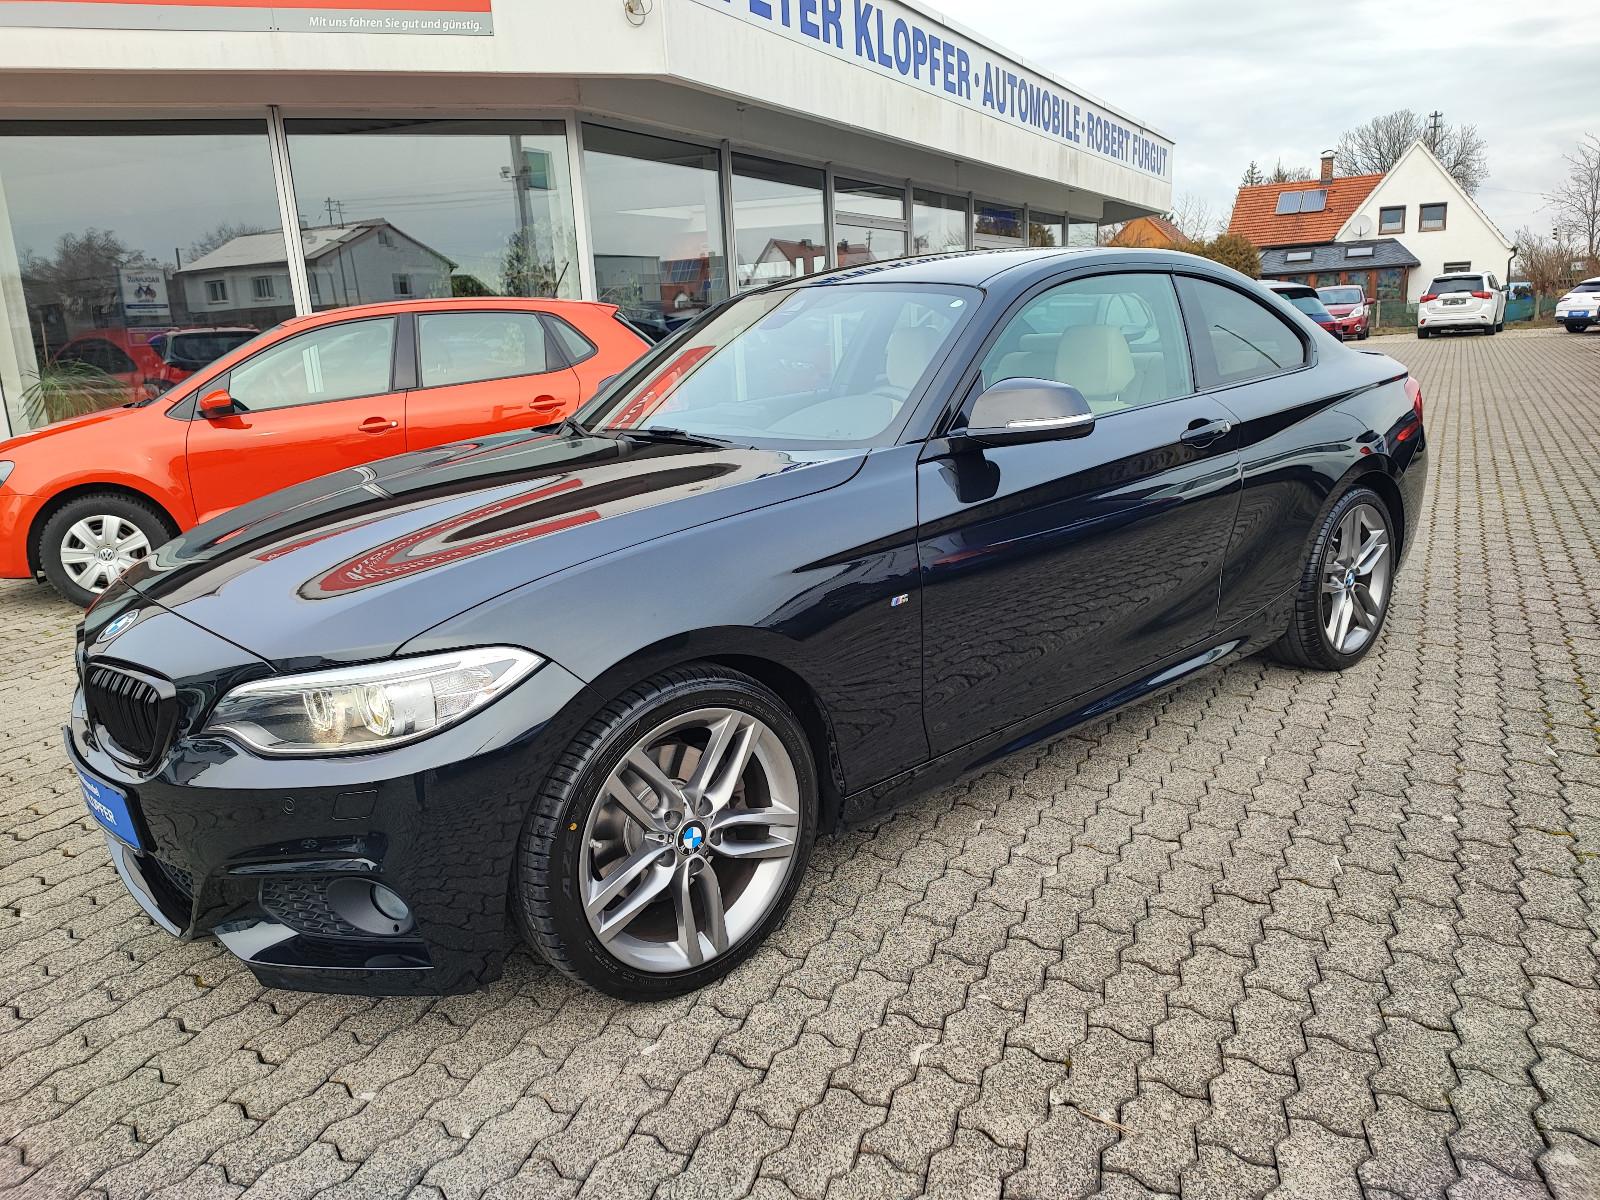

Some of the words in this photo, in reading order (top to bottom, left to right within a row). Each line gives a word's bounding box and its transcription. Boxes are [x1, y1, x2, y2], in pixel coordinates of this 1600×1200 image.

[308, 16, 327, 27] Mit
[328, 18, 347, 28] uns
[349, 16, 383, 29] fahren
[385, 17, 400, 28] Sie
[401, 19, 419, 31] gut
[421, 18, 441, 30] und
[442, 19, 483, 32] günstig.
[854, 0, 971, 100] KLOPFER
[982, 61, 1080, 143] AUTOMOBILE
[1087, 111, 1131, 162] ROBERT
[1132, 128, 1168, 176] FÜRGUT
